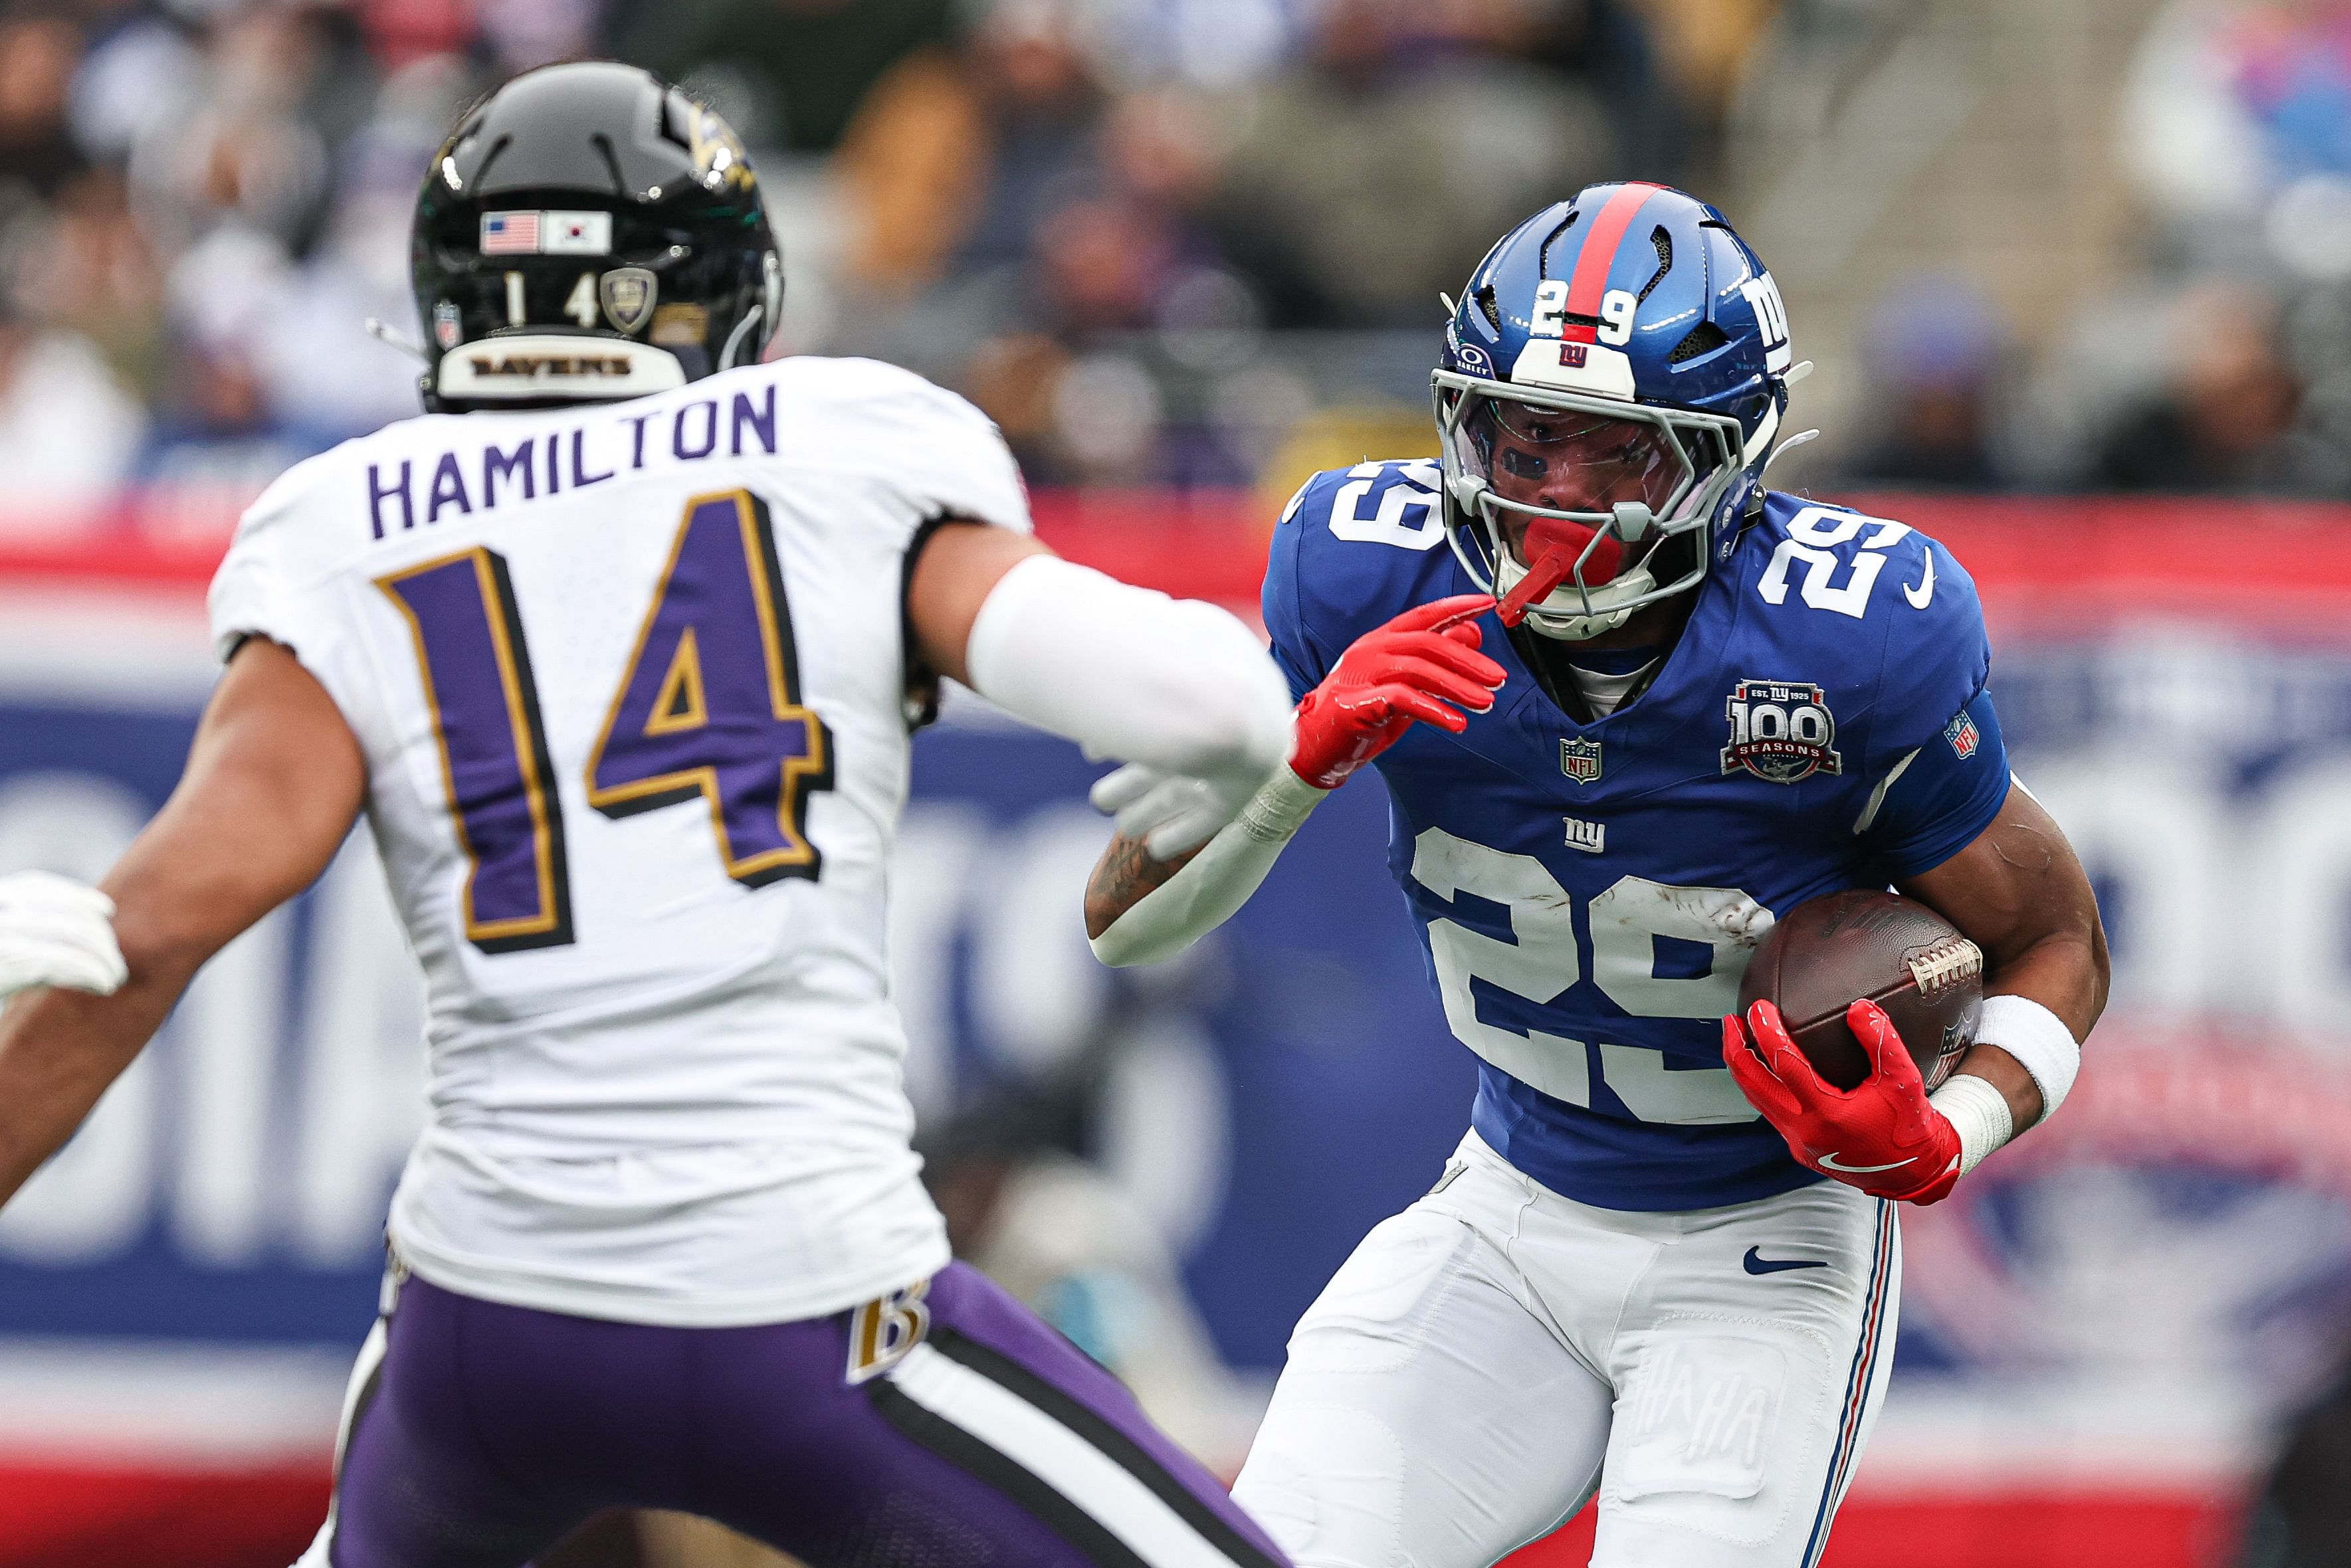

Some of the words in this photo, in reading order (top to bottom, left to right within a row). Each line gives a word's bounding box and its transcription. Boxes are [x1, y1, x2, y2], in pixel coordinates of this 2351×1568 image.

[367, 383, 776, 540] HAMILTON
[1757, 507, 1914, 619] 29
[1751, 689, 1769, 698] EST.
[370, 487, 835, 956] 14
[1731, 702, 1828, 747] 100
[1954, 725, 1977, 755] NFL
[1568, 757, 1596, 776] NFL
[1740, 743, 1820, 757] SEASONS
[1410, 826, 1776, 1125] 29
